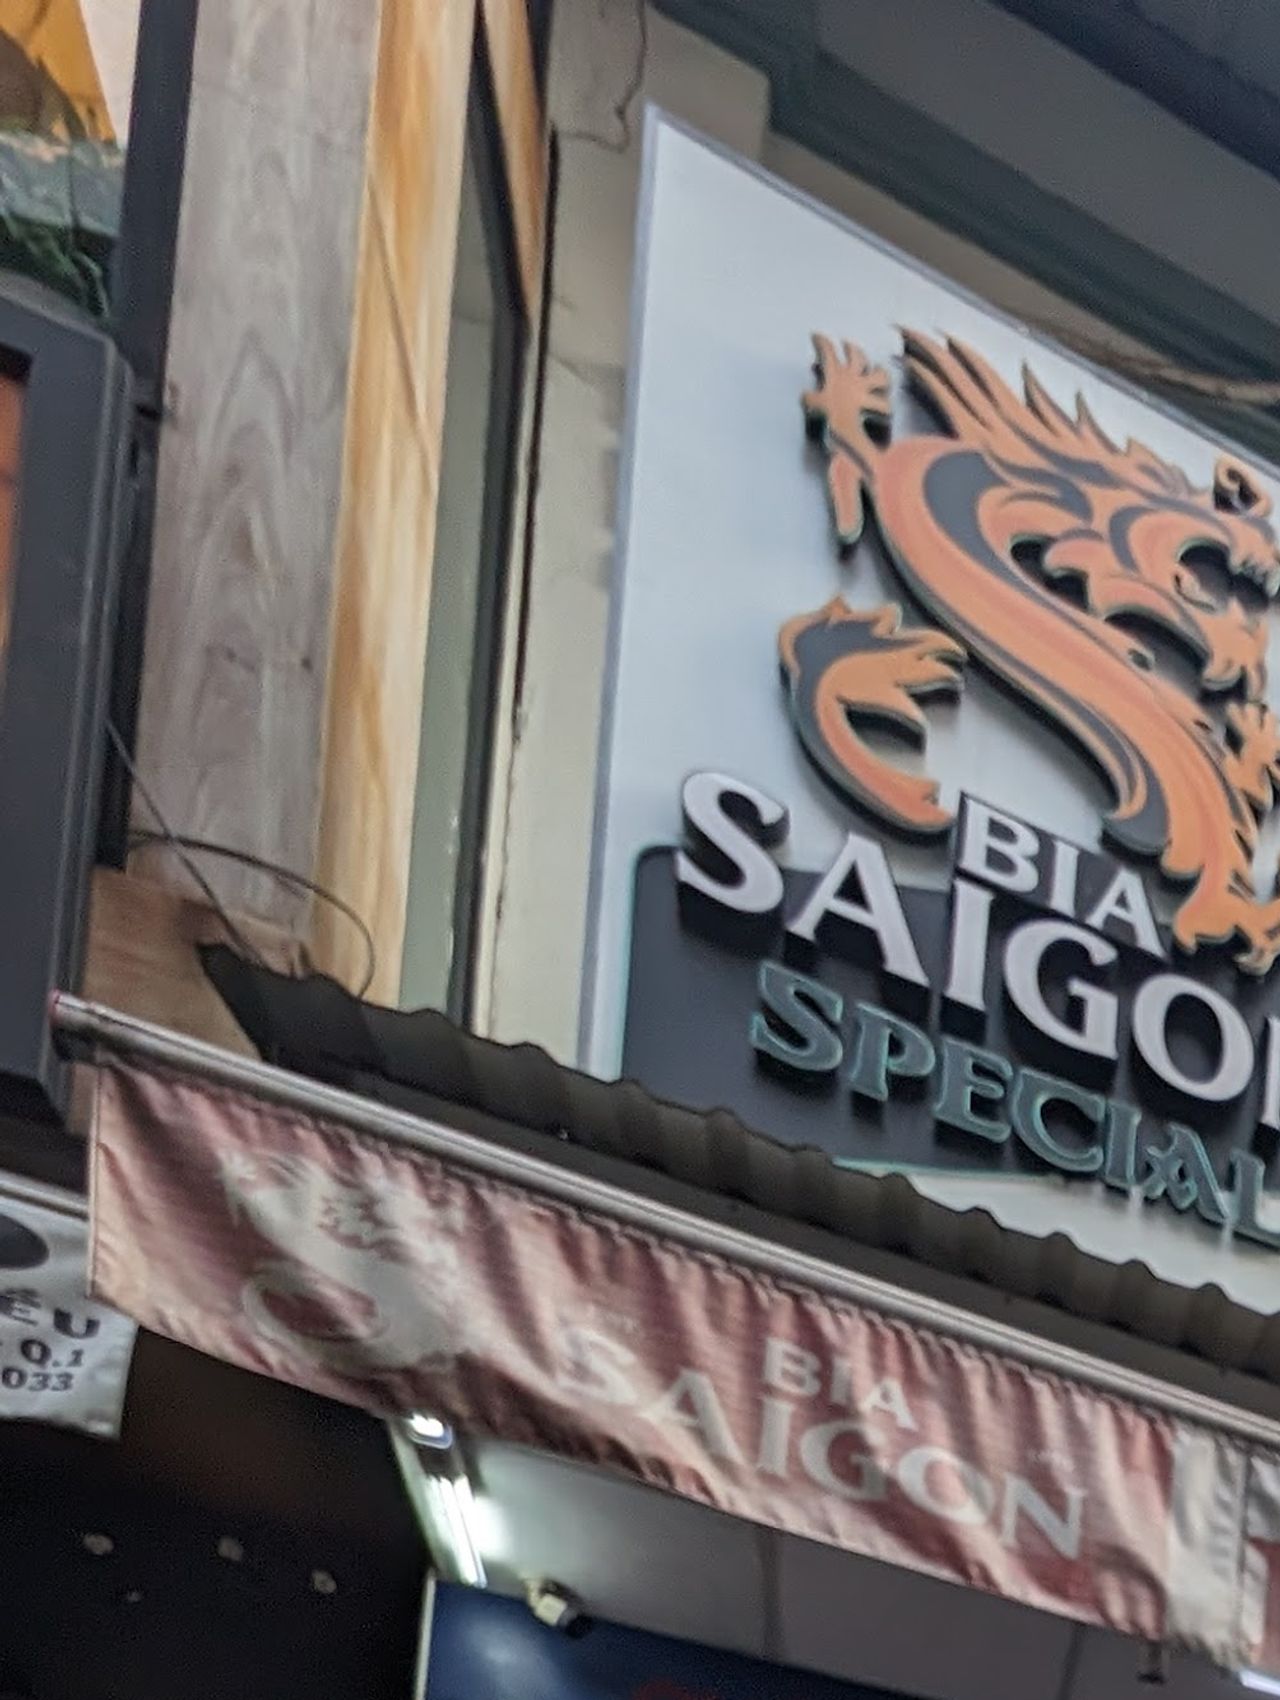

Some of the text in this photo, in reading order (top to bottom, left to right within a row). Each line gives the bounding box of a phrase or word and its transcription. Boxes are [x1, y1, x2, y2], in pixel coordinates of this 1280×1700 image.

[955, 797, 1163, 955] BIA
[20, 1339, 84, 1369] Q.1
[763, 1337, 919, 1431] BIA
[555, 1325, 1089, 1559] SAIGON
